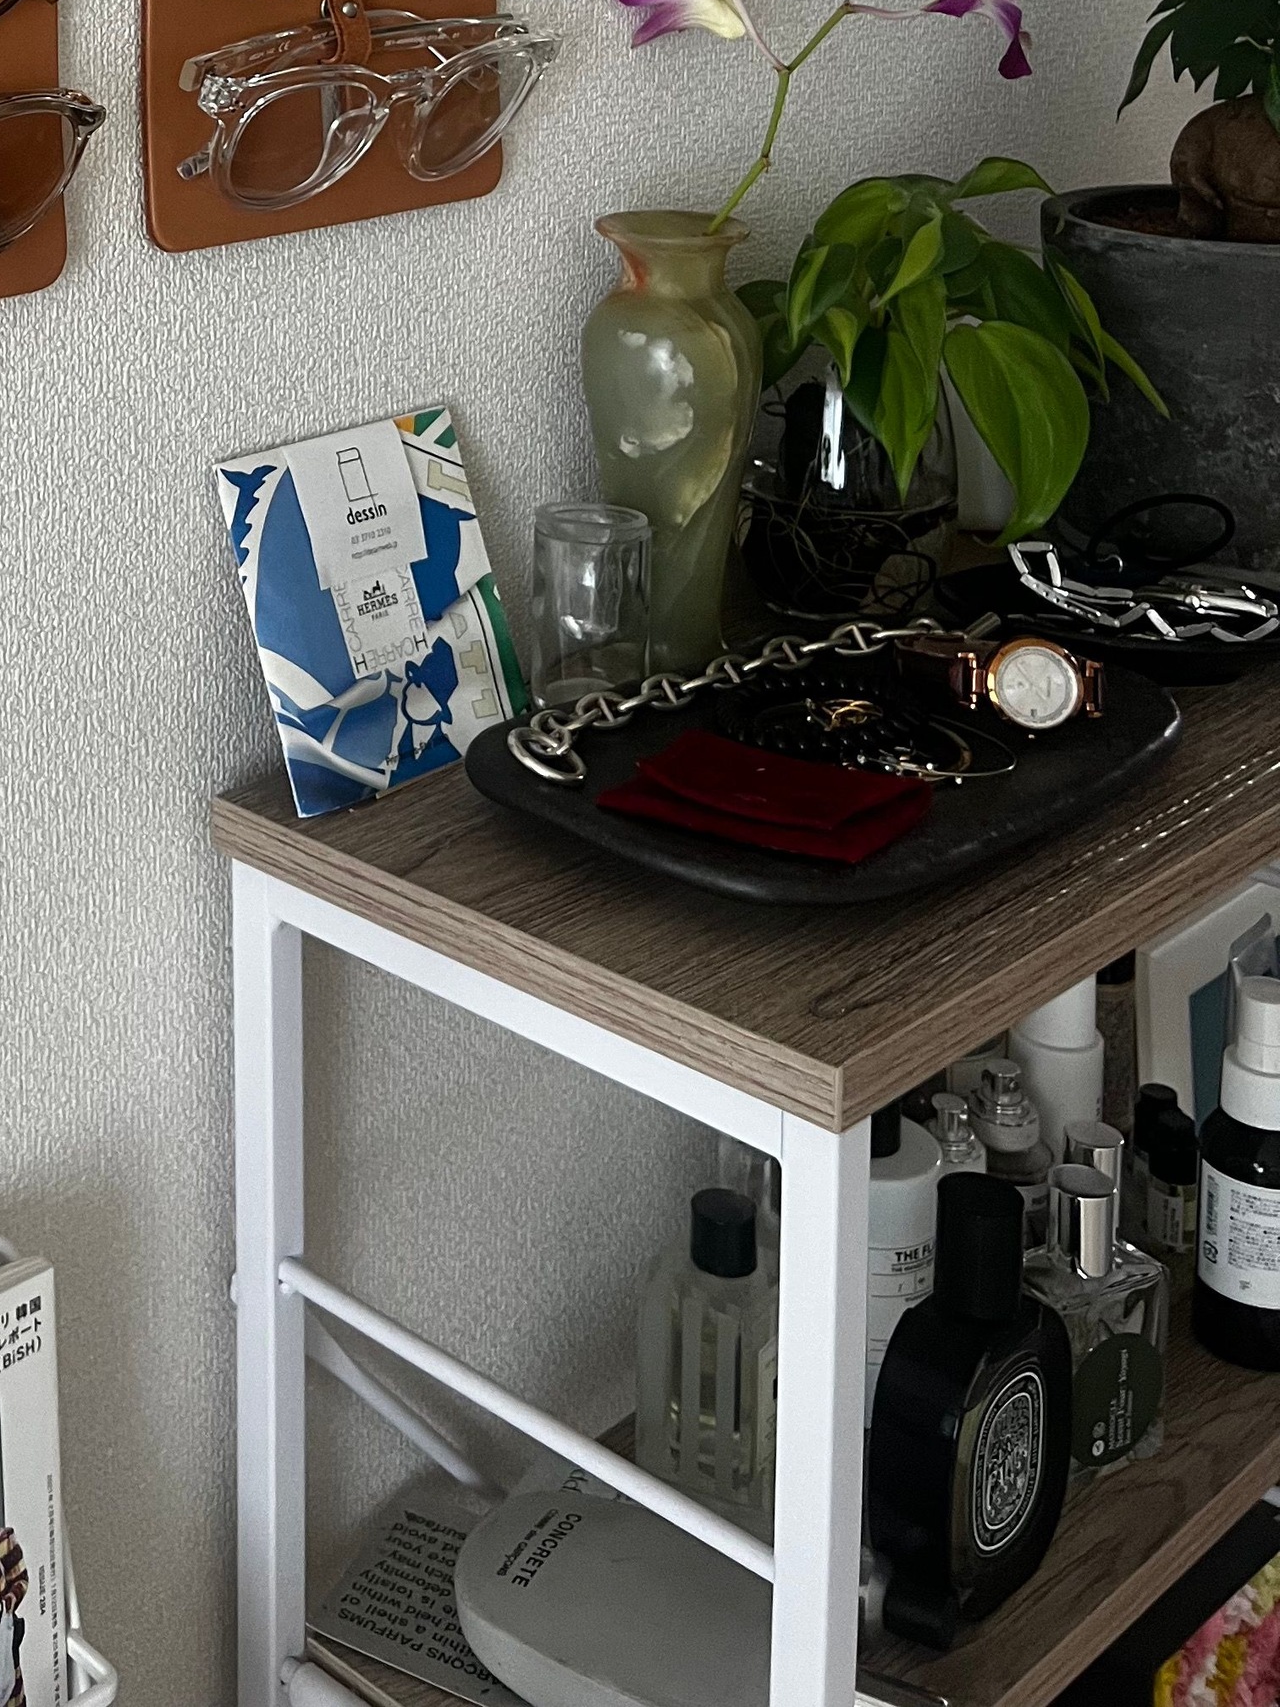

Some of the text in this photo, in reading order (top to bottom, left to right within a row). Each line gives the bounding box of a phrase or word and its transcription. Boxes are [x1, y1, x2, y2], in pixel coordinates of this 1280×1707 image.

[346, 502, 388, 526] dessin
[412, 631, 429, 652] H
[352, 652, 369, 674] H
[895, 1247, 919, 1262] THE
[15, 1294, 43, 1321] 韓国
[391, 1522, 438, 1545] avoid
[384, 1535, 422, 1555] your
[511, 1513, 582, 1588] CONCRETE
[389, 1549, 422, 1570] may
[360, 1568, 413, 1601] totally
[374, 1558, 452, 1599] deformity
[340, 1593, 360, 1607] of
[351, 1580, 402, 1609] within
[421, 1596, 436, 1610] is
[365, 1604, 408, 1628] shell
[404, 1605, 442, 1627] held
[338, 1607, 423, 1653] PARFUMS
[415, 1625, 426, 1635] a
